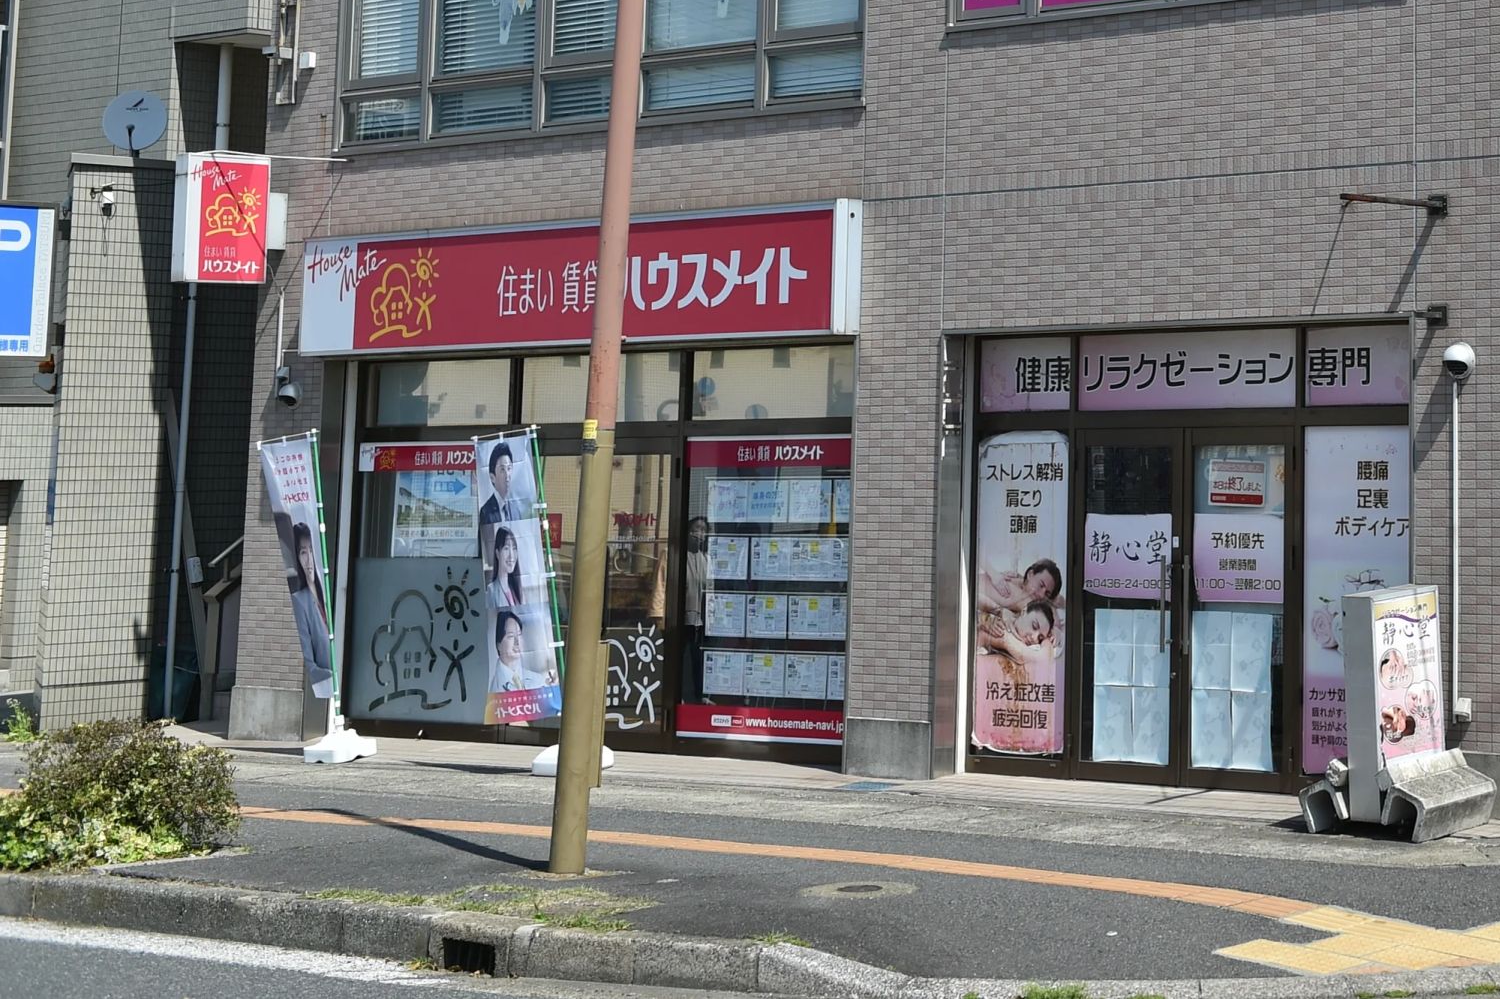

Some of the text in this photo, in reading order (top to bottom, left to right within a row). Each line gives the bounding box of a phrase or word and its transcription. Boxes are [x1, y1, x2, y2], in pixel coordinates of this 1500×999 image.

[190, 163, 221, 182] House
[212, 169, 242, 191] Mate
[202, 259, 261, 274] ハウスメイト
[308, 244, 353, 284] House
[340, 246, 388, 302] Mate
[497, 266, 554, 318] 住まい
[1015, 346, 1372, 394] 健康 リラクゼーション 専門
[774, 445, 824, 460] ハウスメイト
[986, 463, 1064, 482] ストレス解消
[1357, 460, 1389, 480] 腰痛
[1006, 489, 1042, 507] 肩こり
[1357, 489, 1389, 509] 足裏
[1010, 515, 1037, 534] 頭痛
[1335, 516, 1409, 537] ボディケア
[1088, 530, 1168, 565] 静心堂
[1211, 532, 1265, 549] 予約優先
[1219, 558, 1257, 571] 営業時間
[986, 681, 1055, 703] 冷え症改善
[745, 717, 843, 734] www.housemate-navi.jp
[992, 708, 1048, 729] 疲労回復
